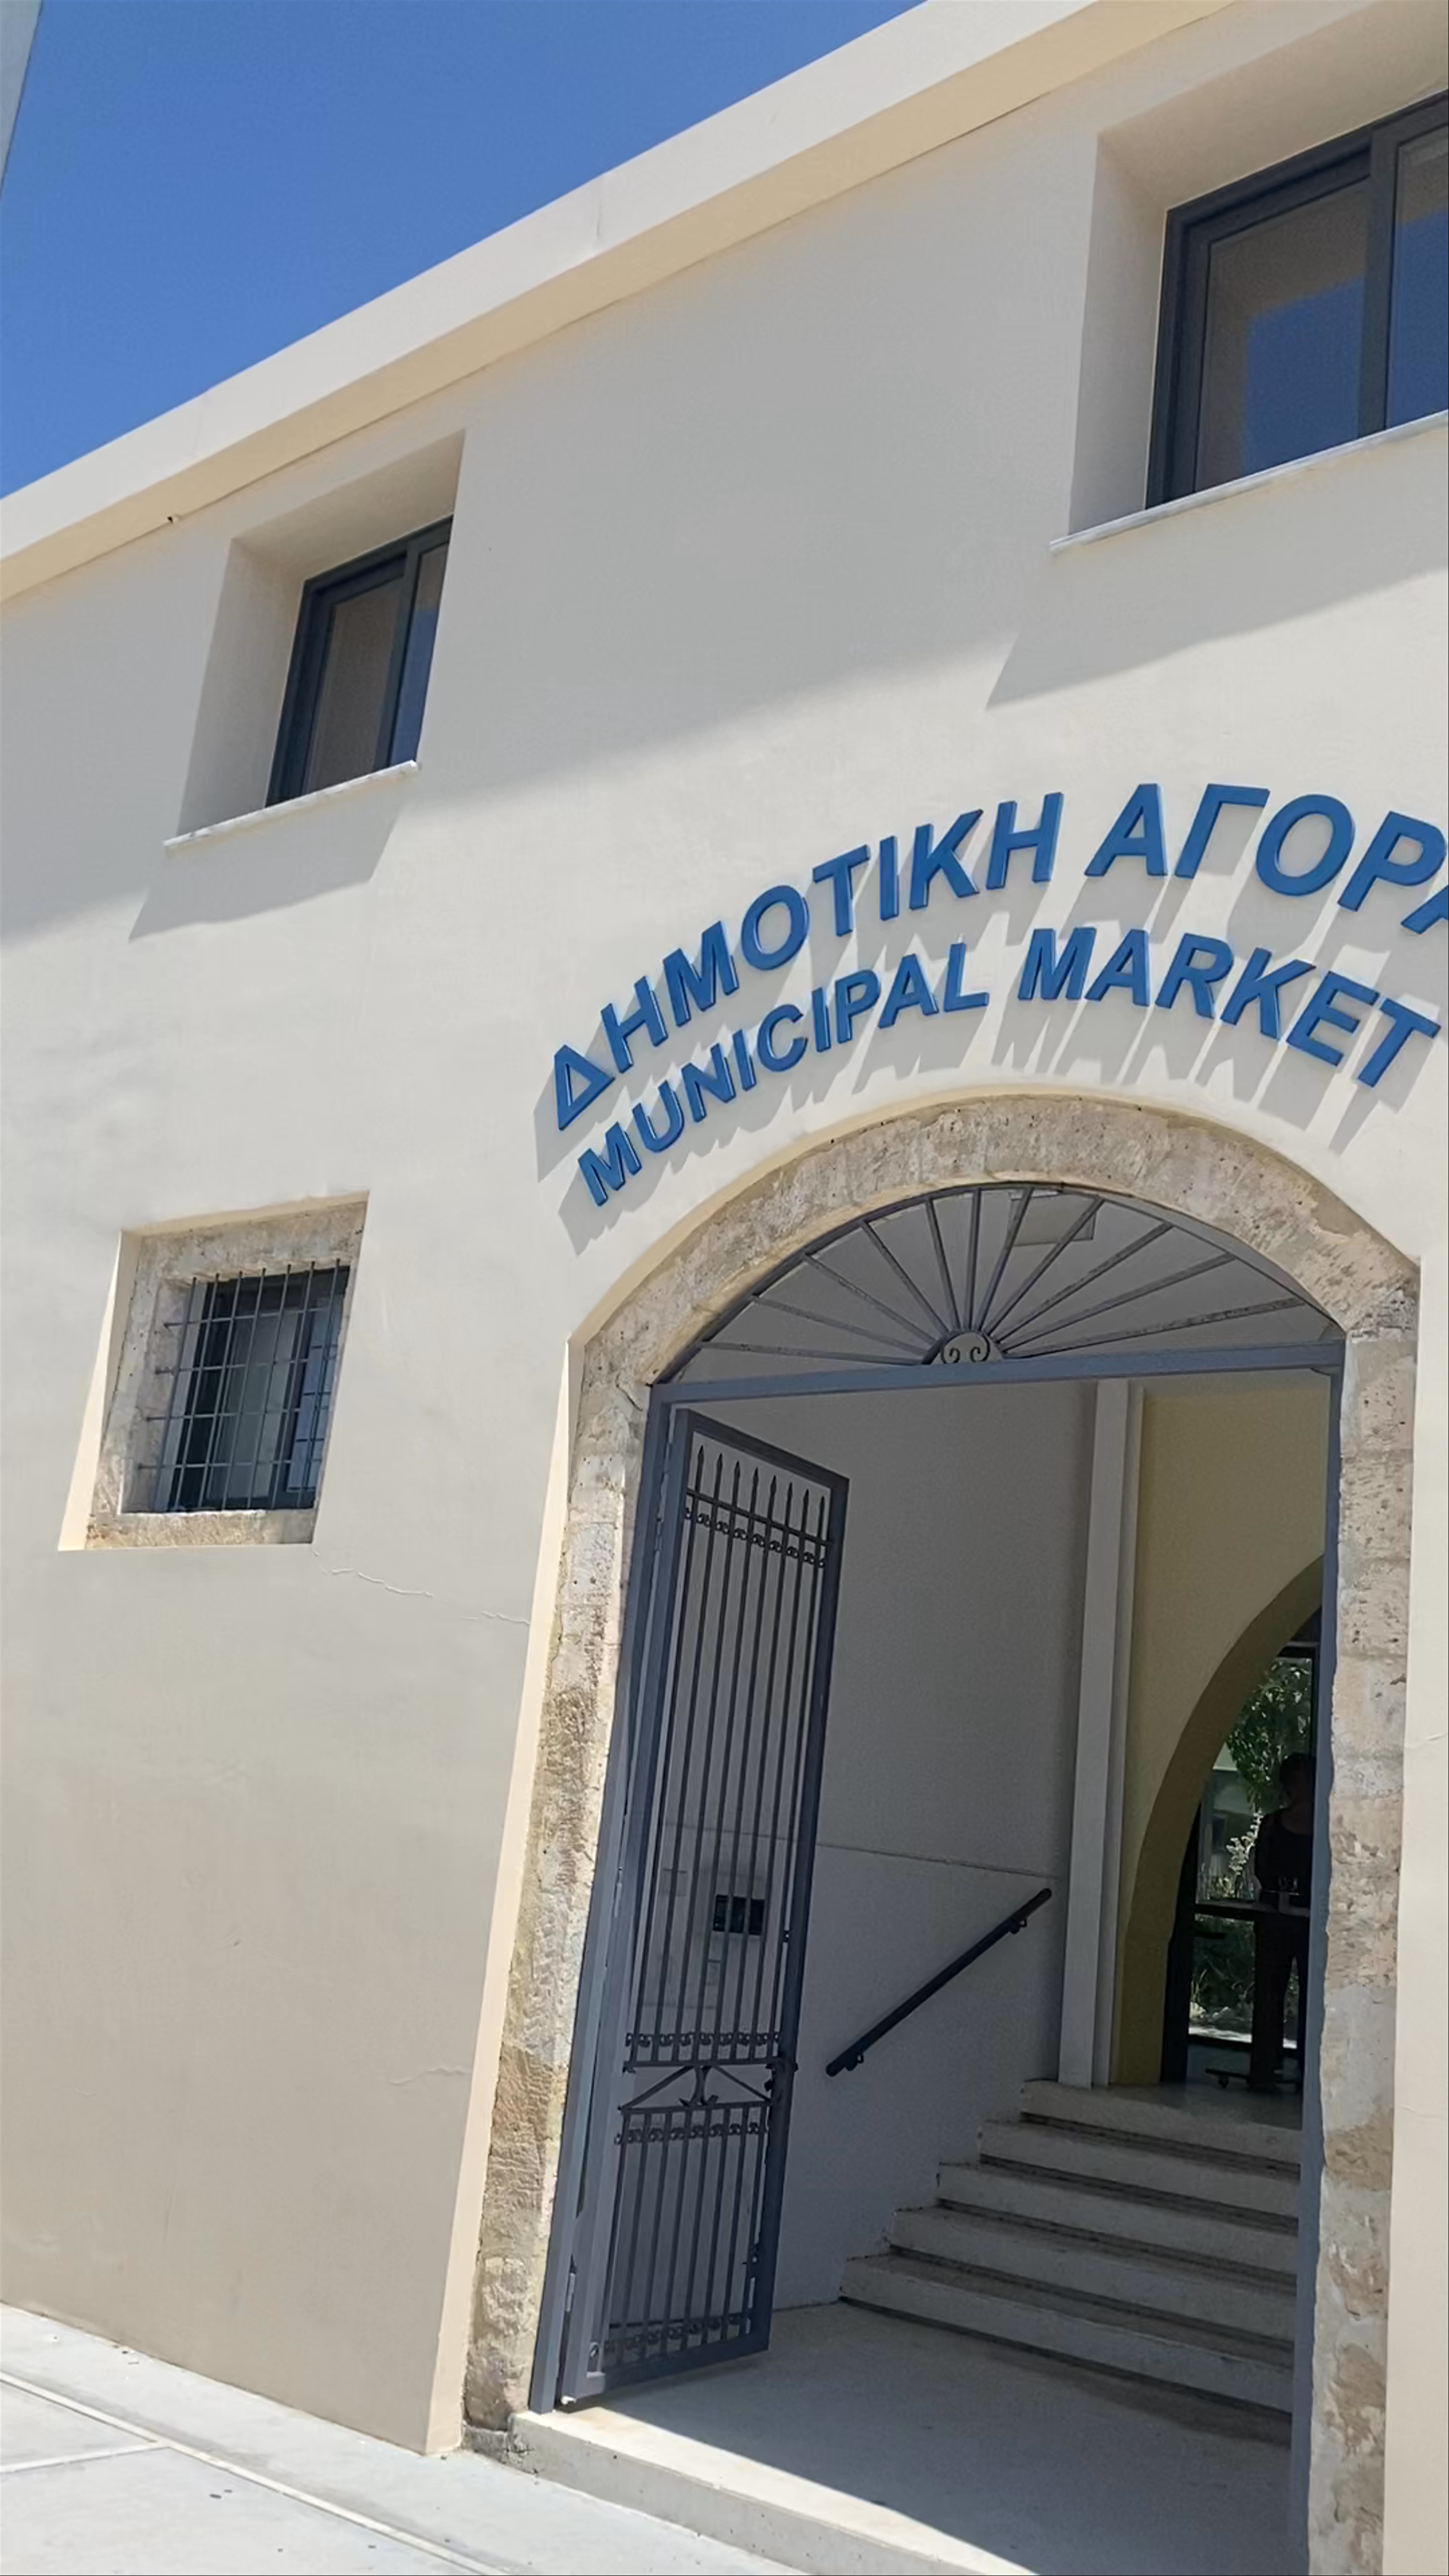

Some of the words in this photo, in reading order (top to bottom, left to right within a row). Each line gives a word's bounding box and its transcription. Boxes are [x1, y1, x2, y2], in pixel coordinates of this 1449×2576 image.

[554, 793, 1063, 1131] ΔΗΜΟΤΙΚΗ
[577, 943, 989, 1207] MUNICIPAL
[1017, 927, 1440, 1088] MARKET
